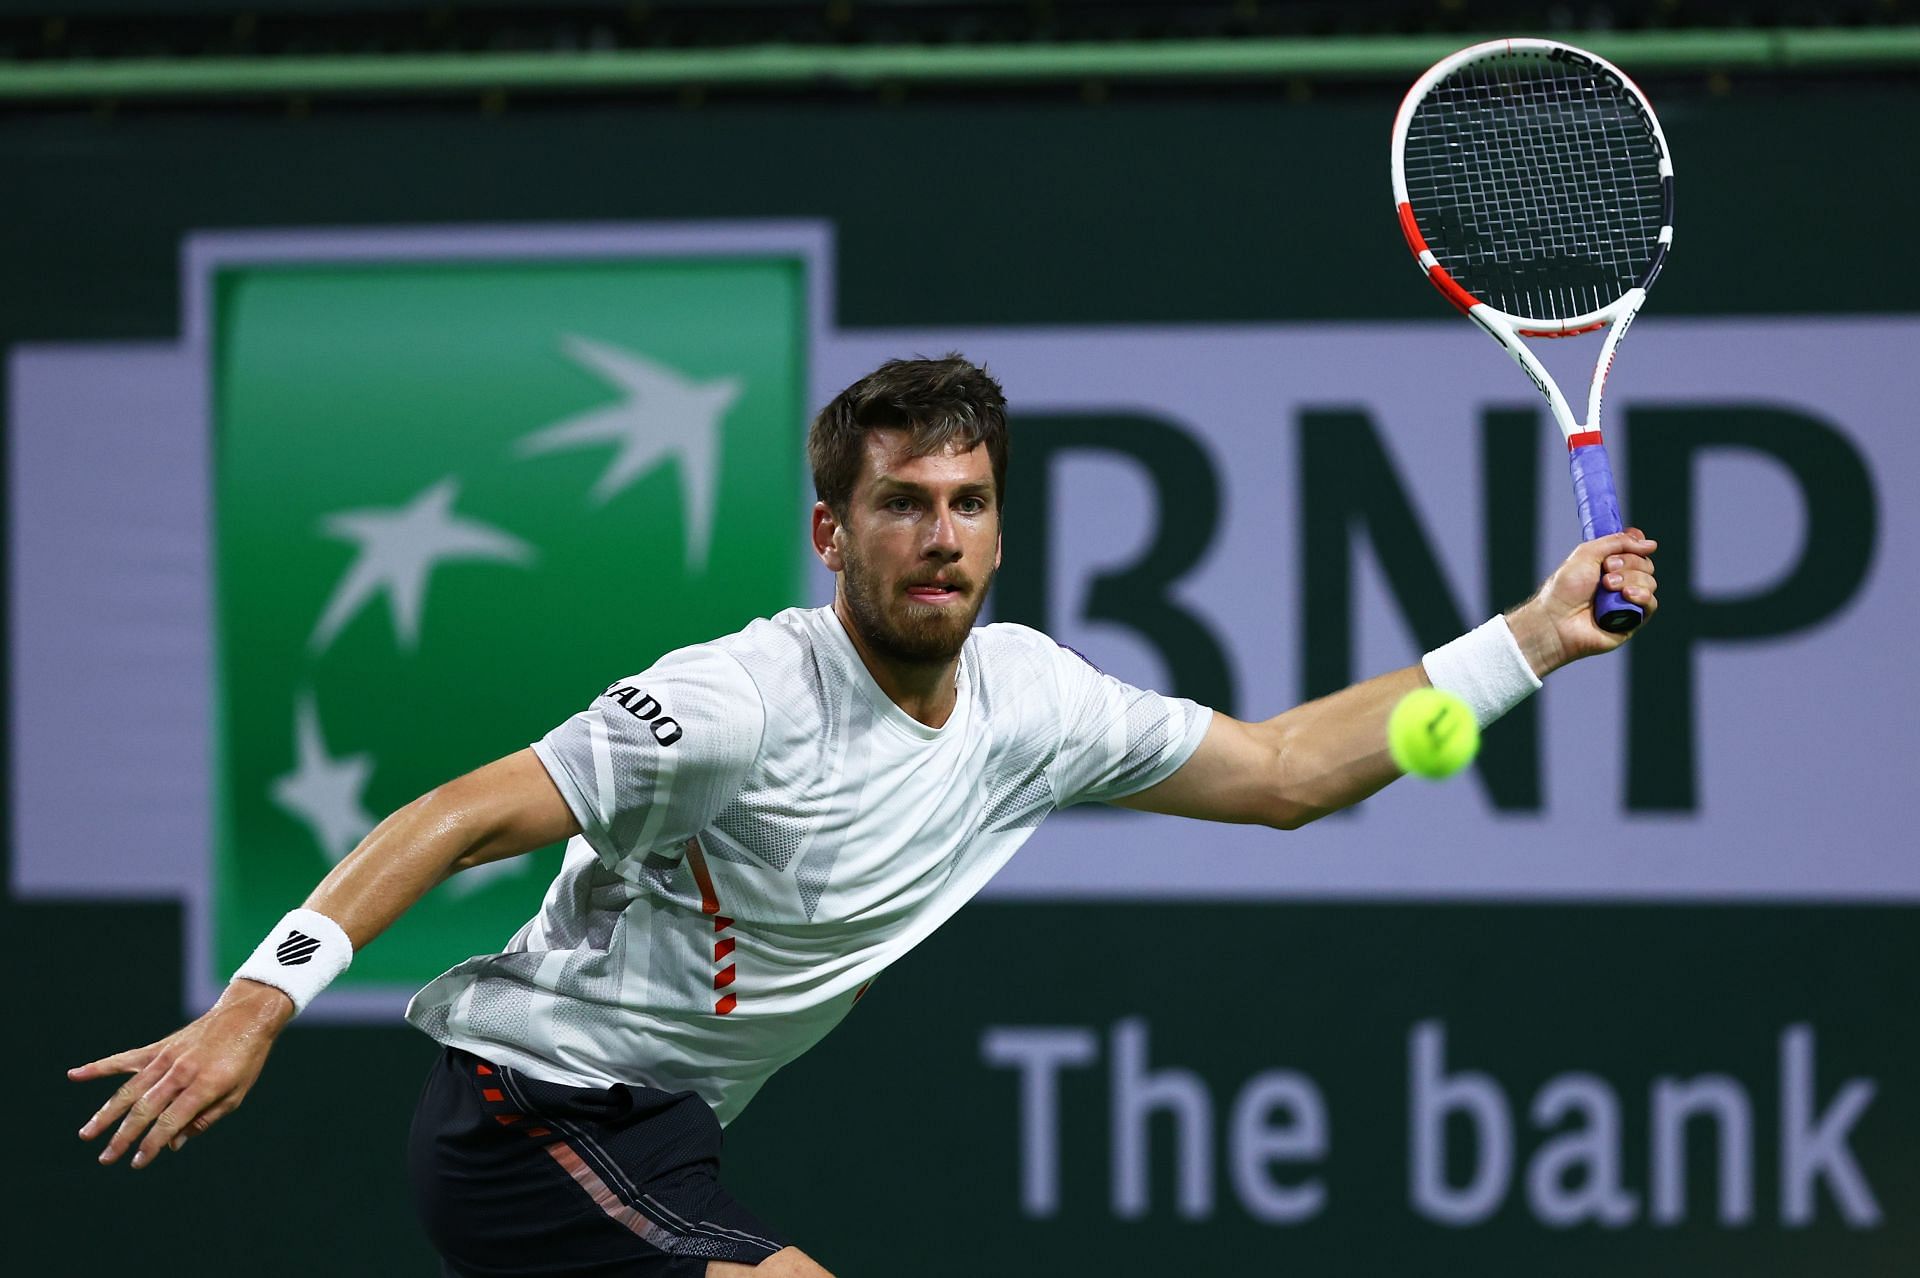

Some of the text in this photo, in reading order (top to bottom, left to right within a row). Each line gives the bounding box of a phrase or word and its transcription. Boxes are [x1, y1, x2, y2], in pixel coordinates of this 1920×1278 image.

[992, 402, 1879, 818] BNP
[601, 682, 683, 747] ADO
[983, 1020, 1880, 1226] The bank
